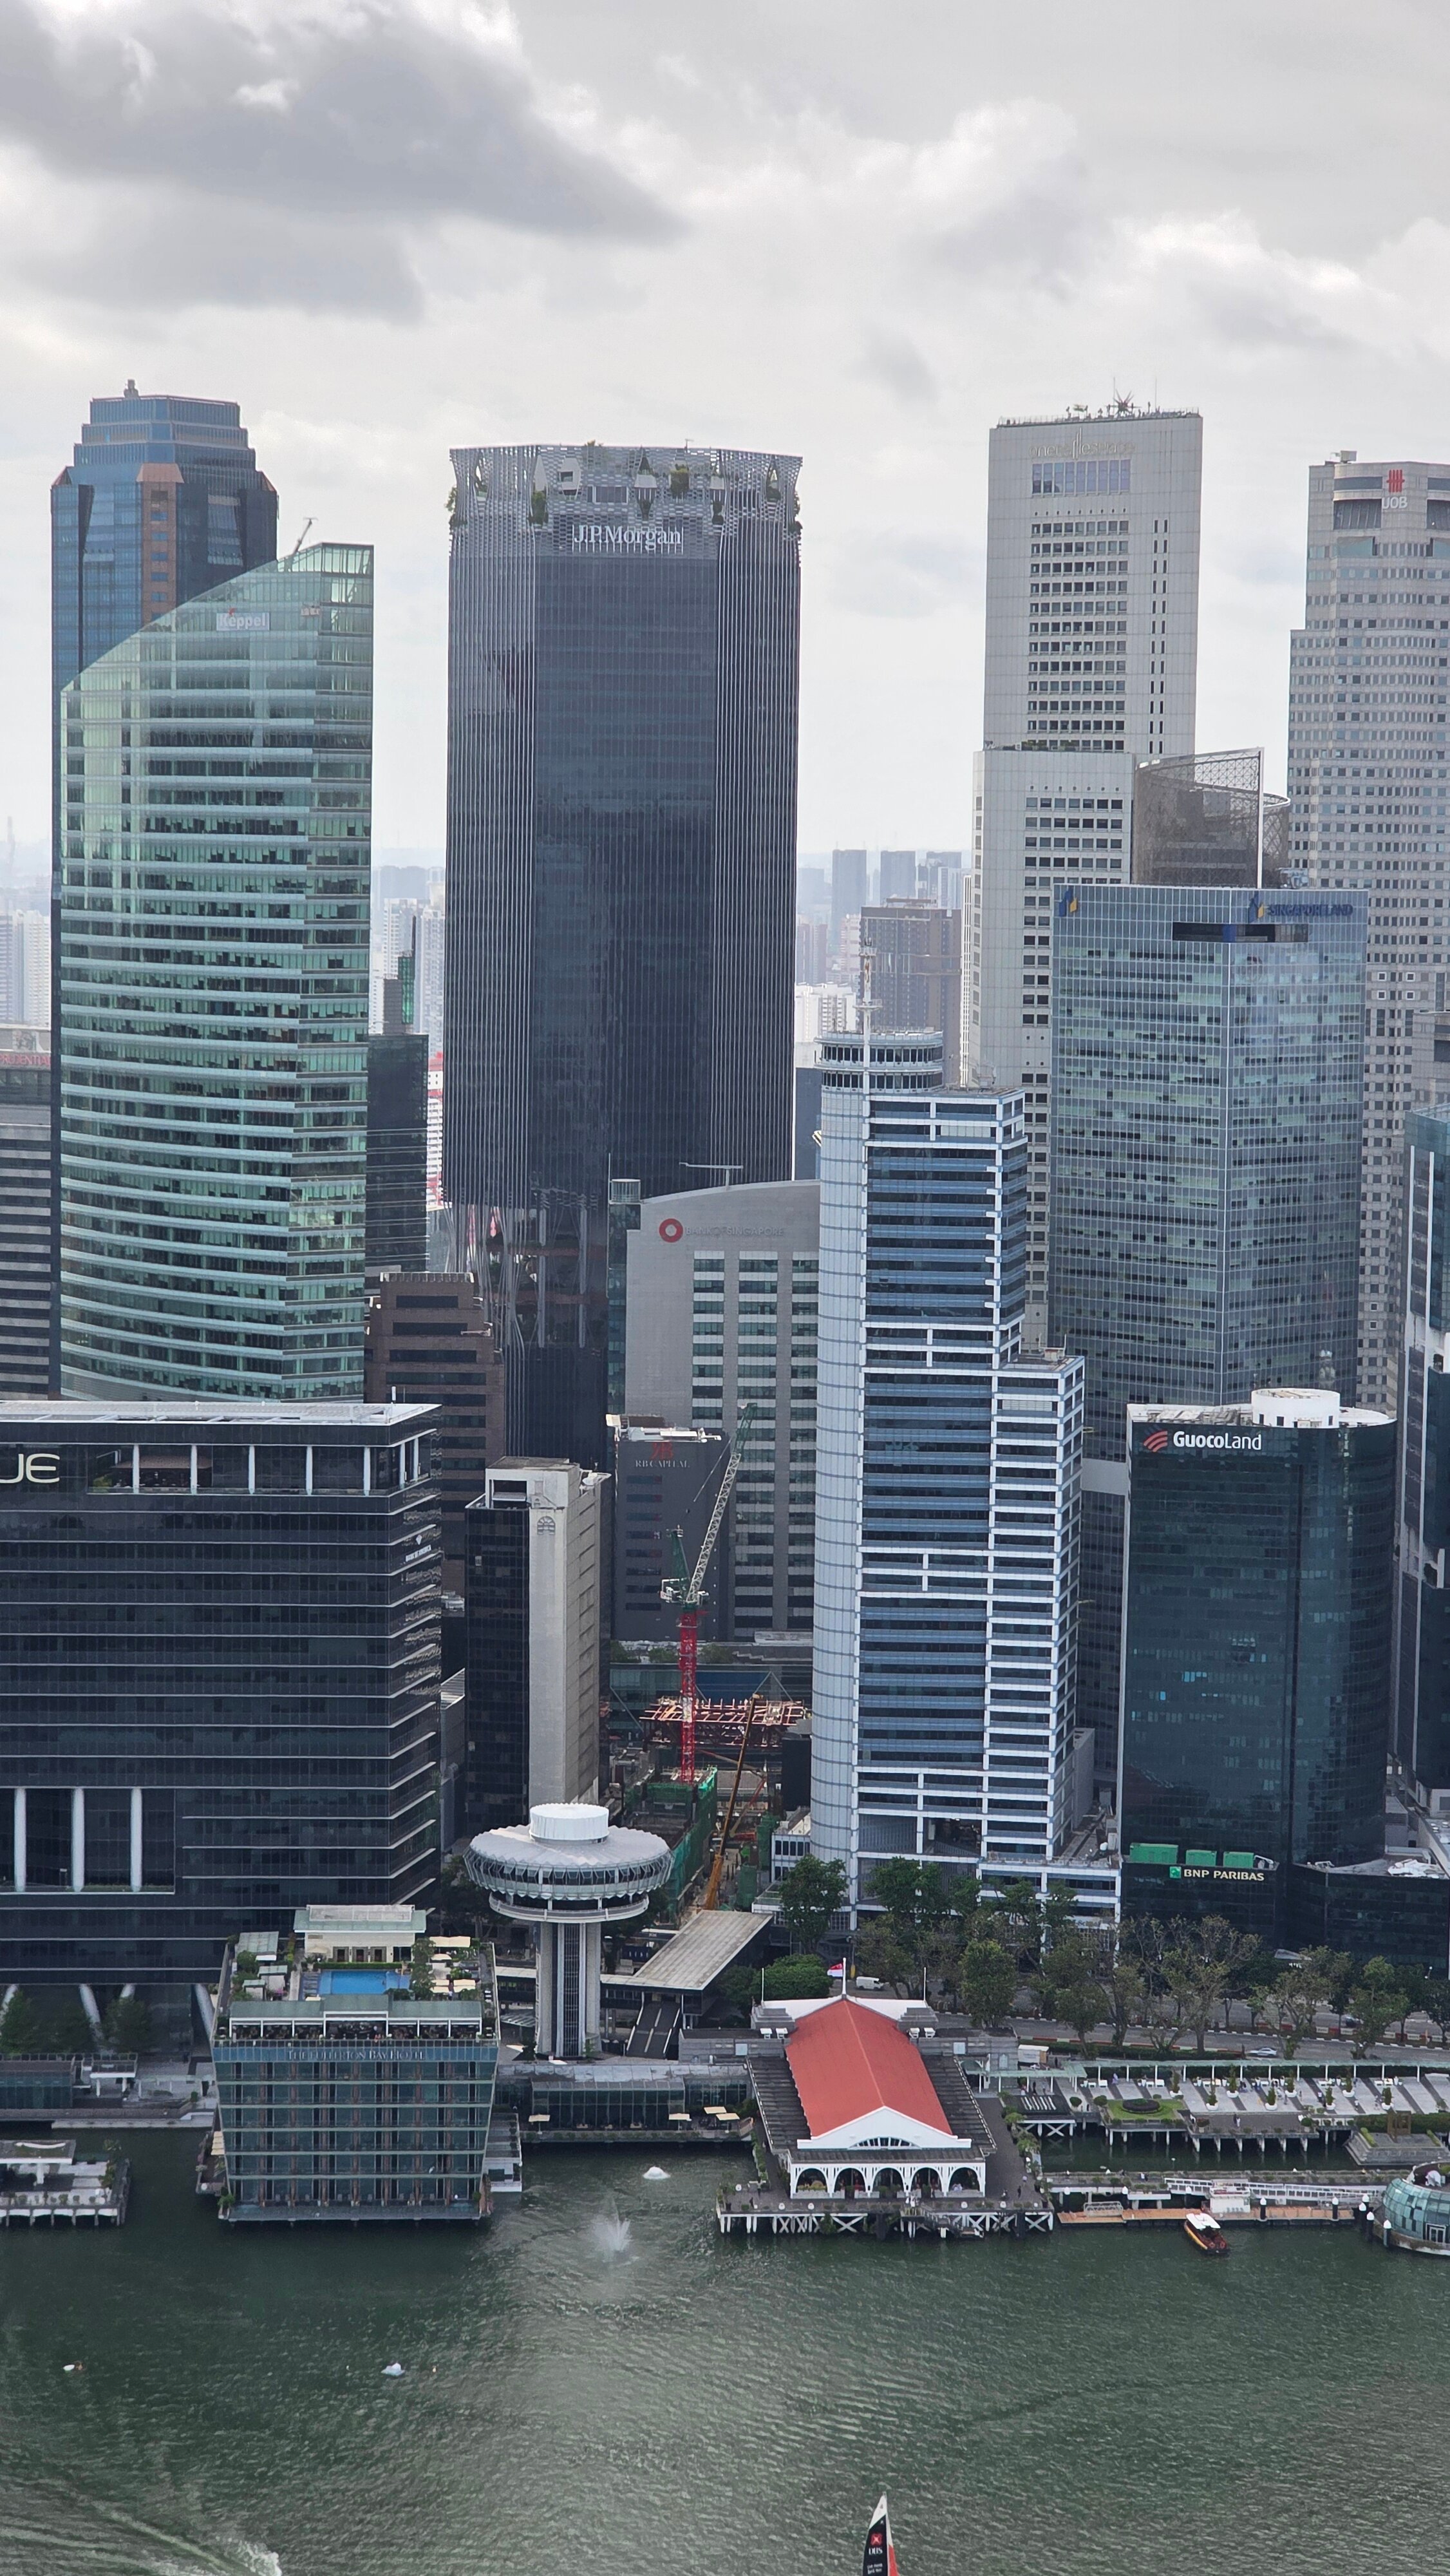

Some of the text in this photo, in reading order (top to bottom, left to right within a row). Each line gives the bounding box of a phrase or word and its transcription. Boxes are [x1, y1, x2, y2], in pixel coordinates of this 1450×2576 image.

[1382, 496, 1408, 509] UOB
[574, 525, 681, 551] J.P.Morgan
[221, 612, 265, 629] Keppel
[726, 1226, 784, 1236] SINGAPORE
[1173, 1430, 1262, 1450] GuocoLand
[1183, 1869, 1265, 1882] BNP PARIBAS
